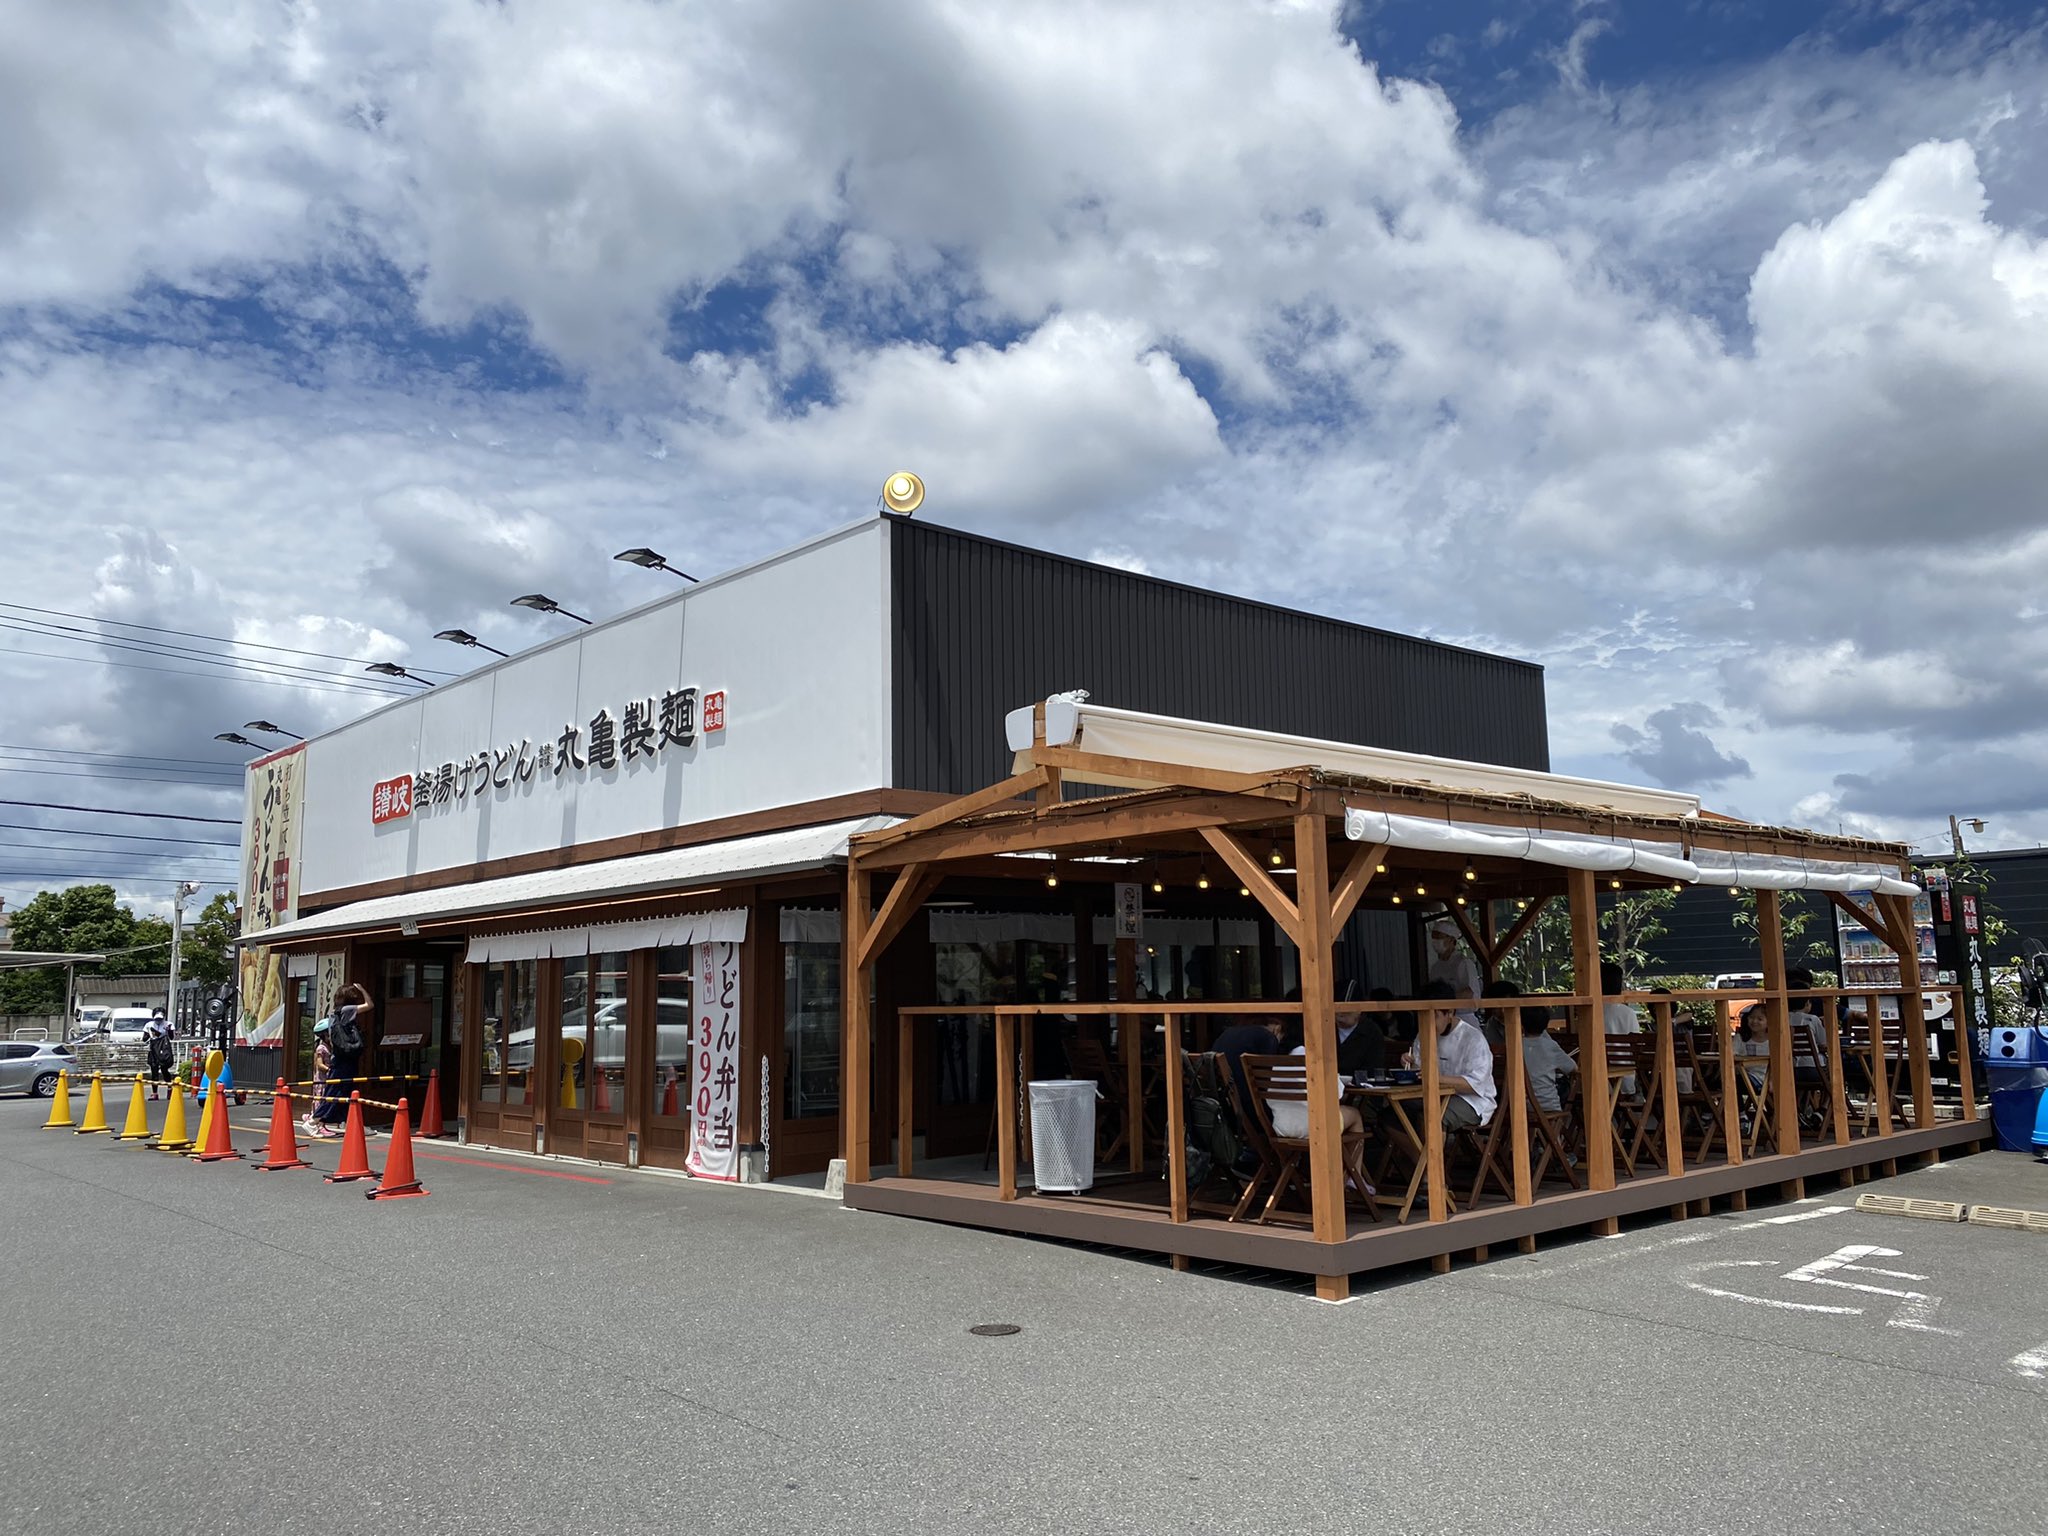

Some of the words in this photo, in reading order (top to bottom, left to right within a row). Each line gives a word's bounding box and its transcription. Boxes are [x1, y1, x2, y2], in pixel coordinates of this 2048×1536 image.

[374, 779, 411, 820] 讃岐
[412, 738, 536, 811] 釜揚げうどん
[553, 687, 697, 777] 丸亀製麺
[704, 694, 723, 712] 丸亀
[1968, 935, 1990, 1056] 丸亀製麺
[696, 1016, 712, 1138] 390円
